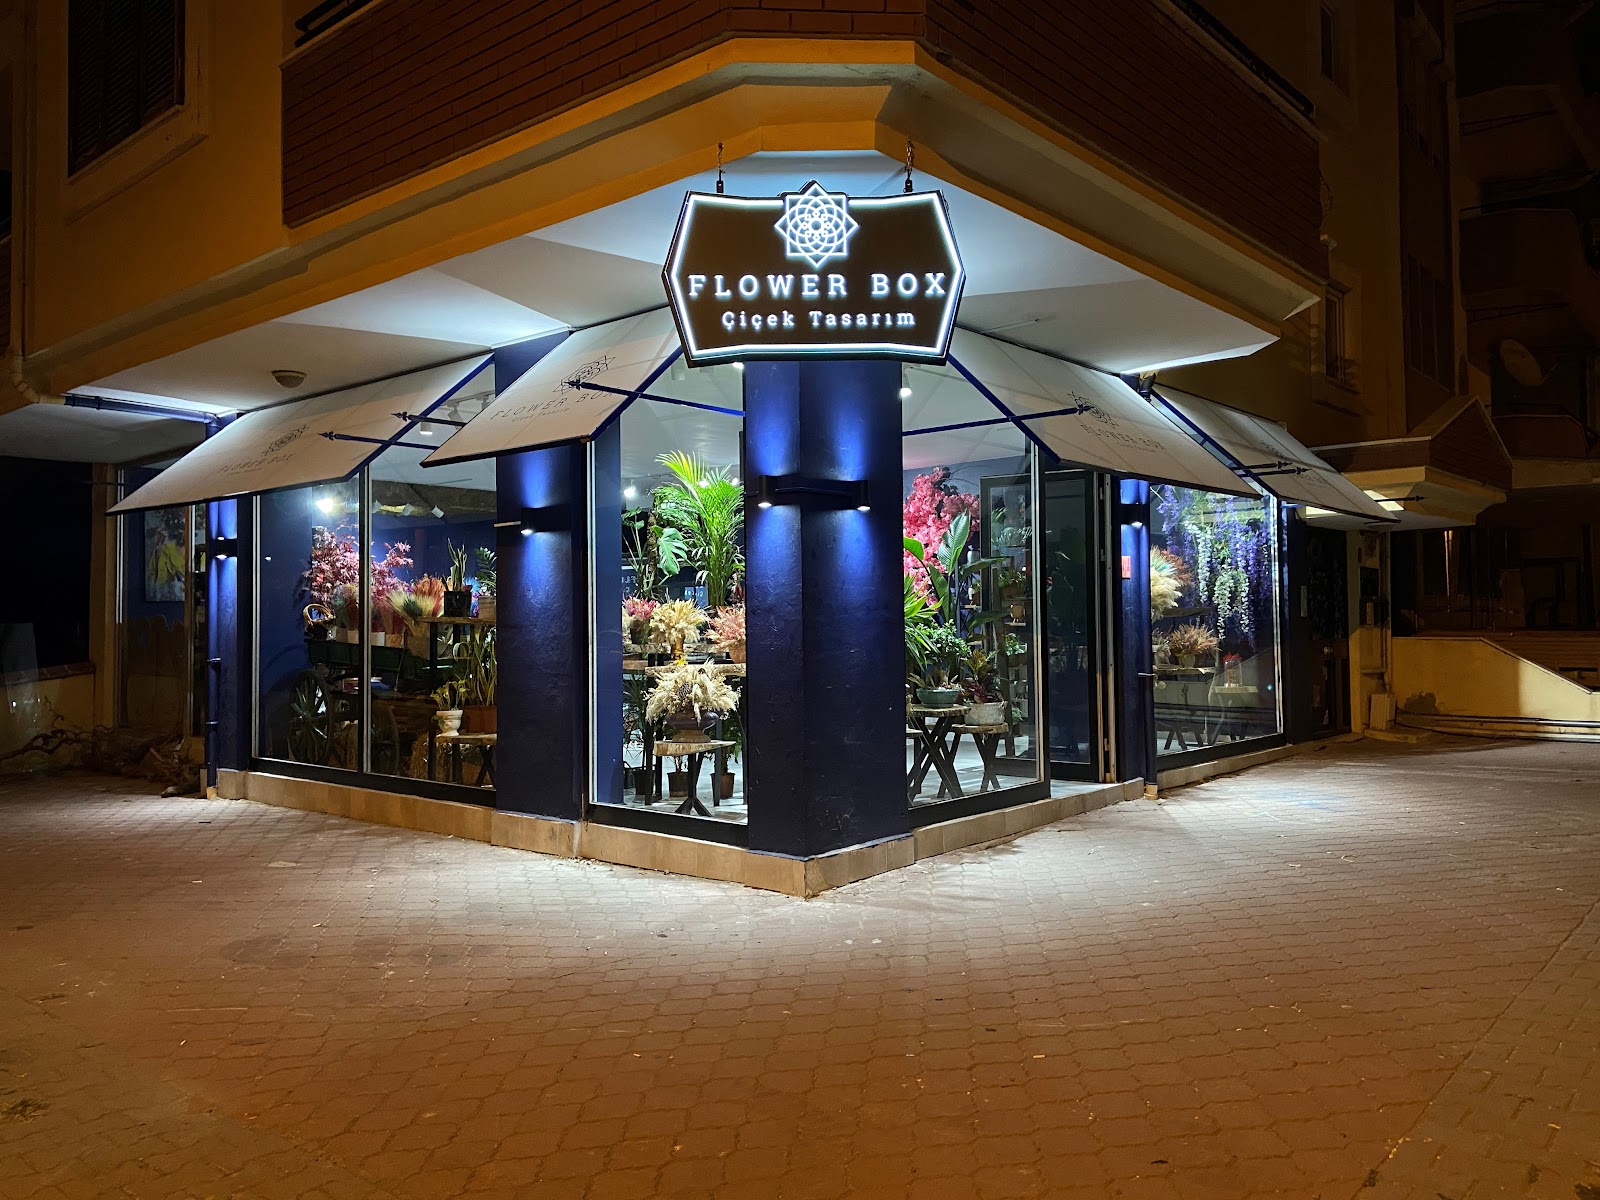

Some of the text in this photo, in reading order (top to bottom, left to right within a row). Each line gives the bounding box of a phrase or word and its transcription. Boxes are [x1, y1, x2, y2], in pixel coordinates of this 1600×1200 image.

[688, 272, 946, 298] FLOWER BOX
[721, 310, 916, 331] Çiçek Tasarım
[490, 397, 568, 420] FLOWER
